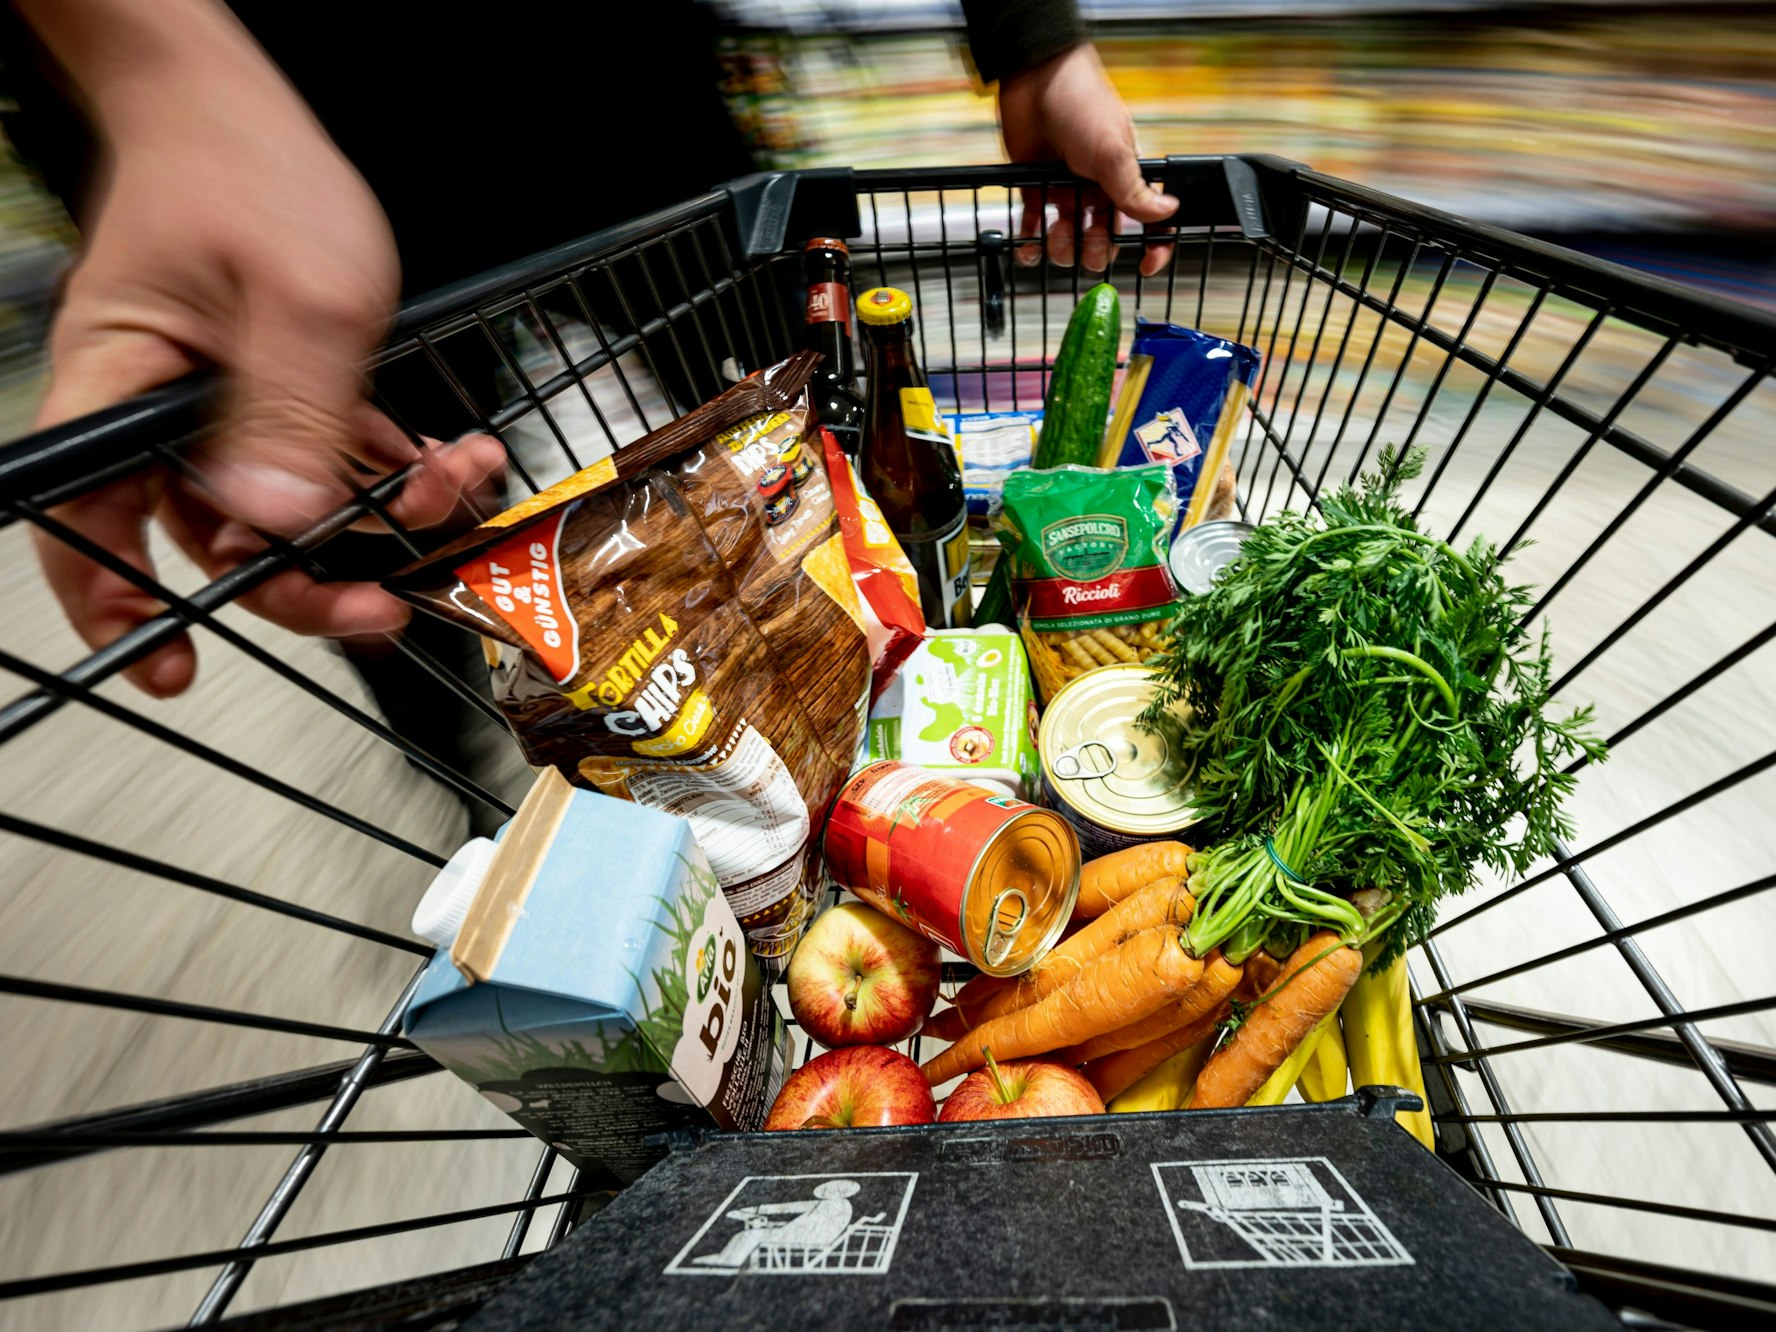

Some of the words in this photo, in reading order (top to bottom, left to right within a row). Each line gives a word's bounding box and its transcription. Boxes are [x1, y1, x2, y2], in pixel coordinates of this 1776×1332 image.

[1049, 523, 1121, 546] SANSEPOLCRO
[1059, 542, 1115, 555] FACTORY
[489, 562, 516, 612] GUT
[514, 586, 531, 604] &
[530, 542, 561, 648] GÜNSTIG
[1062, 583, 1121, 605] Riccioli
[1057, 618, 1103, 628] SELEZIONATA
[1104, 616, 1113, 624] DI
[1114, 614, 1140, 623] GRANO
[561, 612, 679, 711] TORTILLA
[604, 648, 696, 737] CHIPS
[699, 945, 716, 995] Arla
[699, 939, 736, 1056] bio
[722, 1047, 743, 1107] FRISCHE
[738, 1020, 749, 1043] BIO
